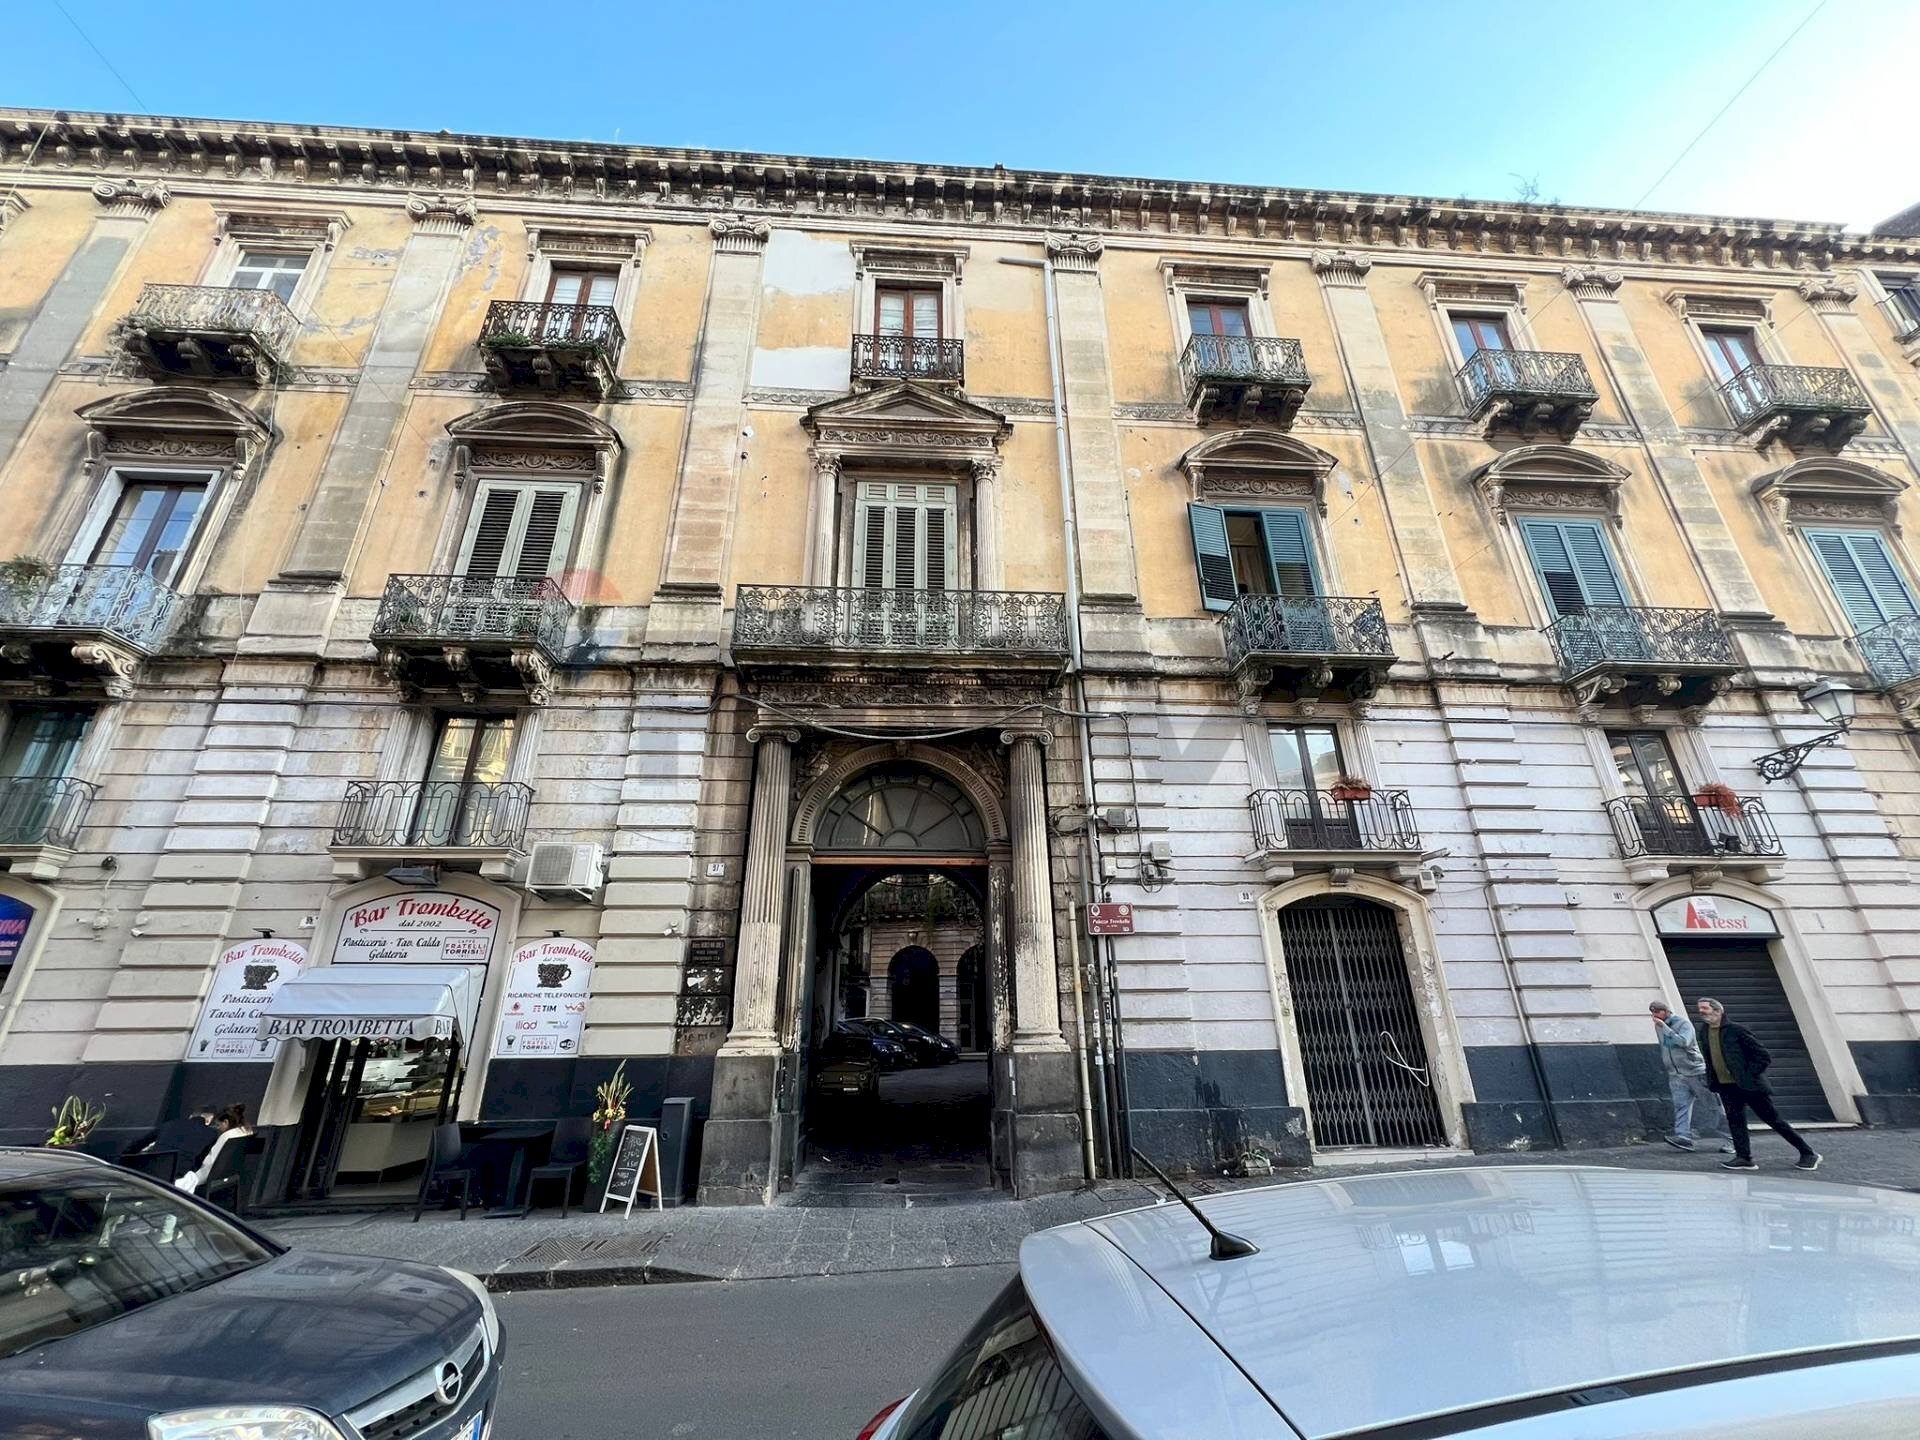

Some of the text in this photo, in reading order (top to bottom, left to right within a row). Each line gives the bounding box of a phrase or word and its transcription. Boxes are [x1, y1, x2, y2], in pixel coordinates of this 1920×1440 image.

[350, 898, 493, 929] Bar Trombetta
[416, 920, 442, 928] 2002
[343, 937, 387, 947] Pasticceria
[416, 937, 441, 948] Calda
[223, 944, 304, 965] Bar Trombetta
[368, 949, 408, 961] Gelateria
[516, 943, 593, 963] Bar Trombetta
[221, 993, 274, 1004] Pasticceri
[209, 1008, 264, 1019] Tavola Ca
[214, 1023, 259, 1036] Gelateri
[268, 1019, 414, 1035] BAR TROMBETTA
